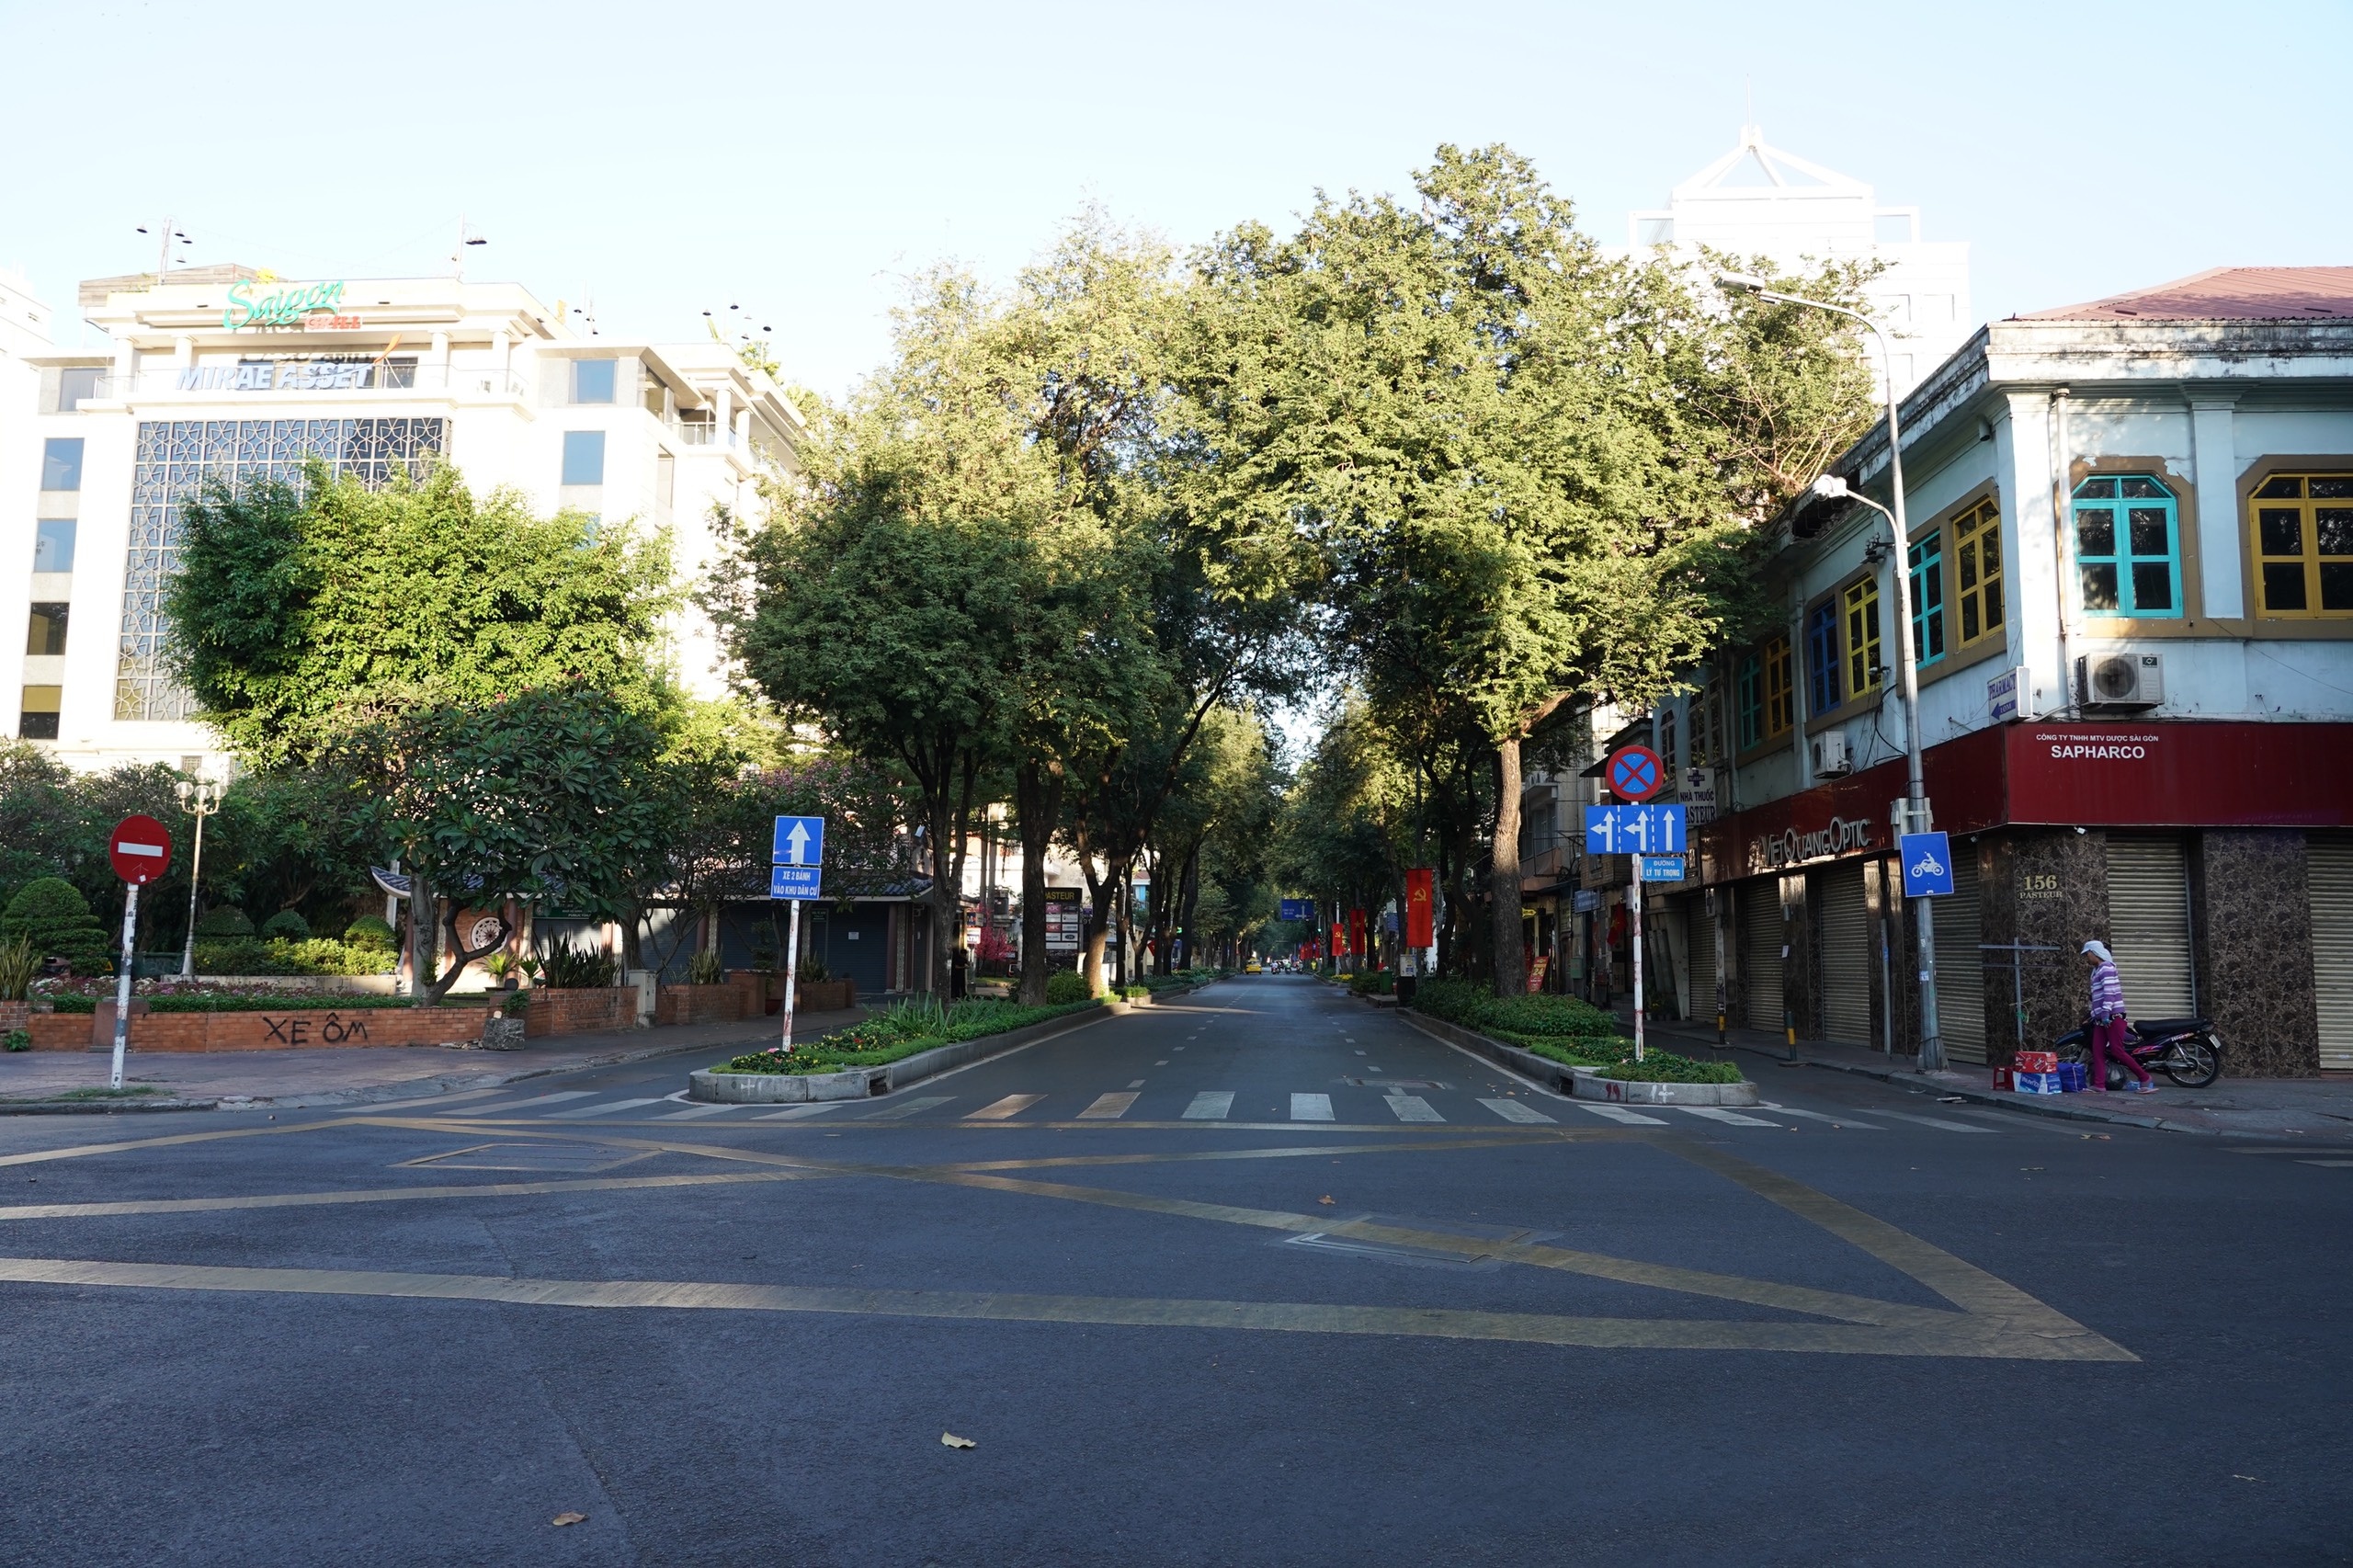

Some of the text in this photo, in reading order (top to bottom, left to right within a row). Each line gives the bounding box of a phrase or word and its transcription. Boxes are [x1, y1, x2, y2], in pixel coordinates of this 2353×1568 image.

[222, 279, 345, 329] Saigon
[304, 315, 361, 330] GRILL
[176, 362, 372, 390] MIRAE ASSET
[1989, 673, 2016, 700] PHARMACY
[2130, 733, 2142, 742] SÀI
[2143, 733, 2159, 742] GÒN
[2051, 745, 2145, 758] SAPHARCO
[1680, 788, 1714, 802] NHÀ THUỐC
[1685, 805, 1716, 824] ASTEUR
[782, 869, 811, 881] XE 2 BÁNH
[1646, 867, 1680, 878] LÝ TƯ TRỌNG
[773, 882, 818, 896] VÀO KHU DÂN CƯ
[2024, 874, 2058, 891] 156
[2019, 891, 2063, 899] PASTEUR
[263, 1012, 368, 1044] XE ÔM
